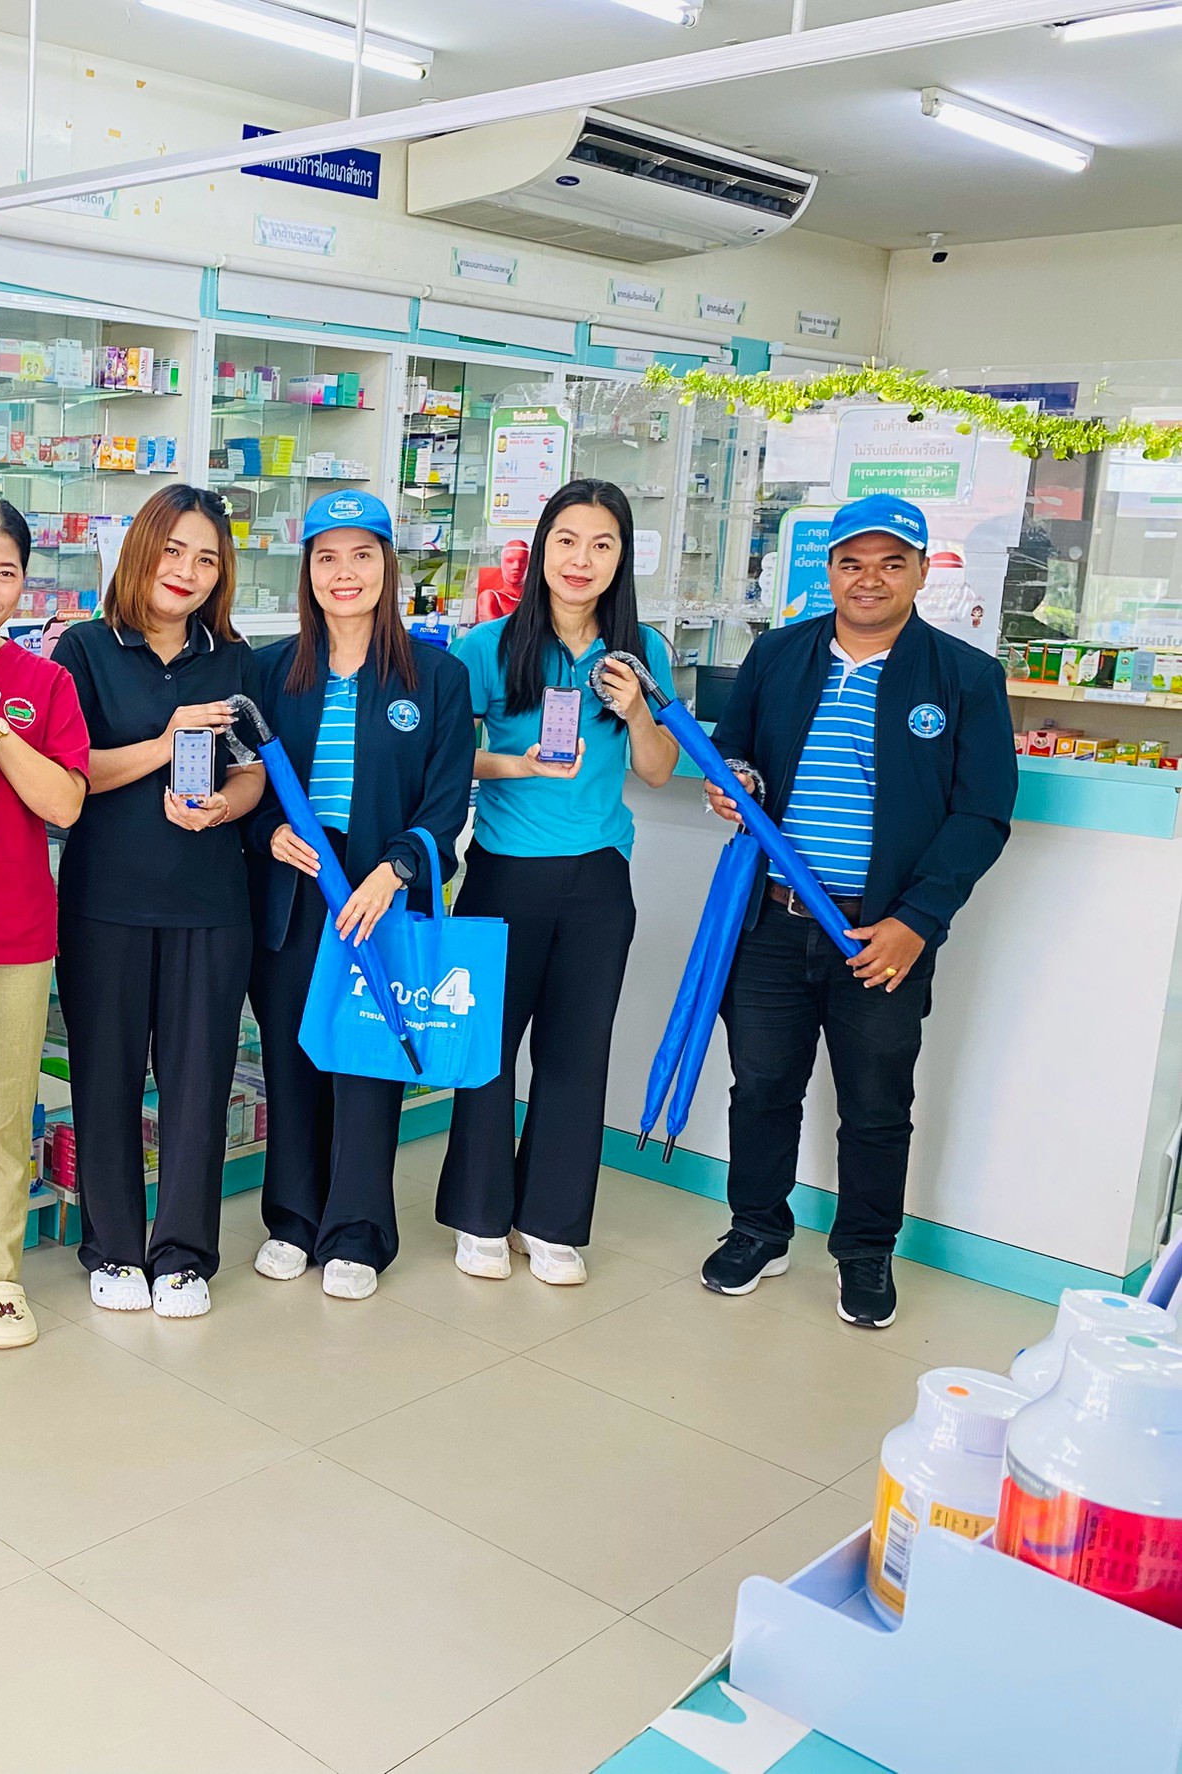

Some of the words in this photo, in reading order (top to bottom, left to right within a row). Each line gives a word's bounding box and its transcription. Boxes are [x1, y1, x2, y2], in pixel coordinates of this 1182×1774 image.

[854, 466, 954, 479] กรุณาตรวจสอบสินค้า
